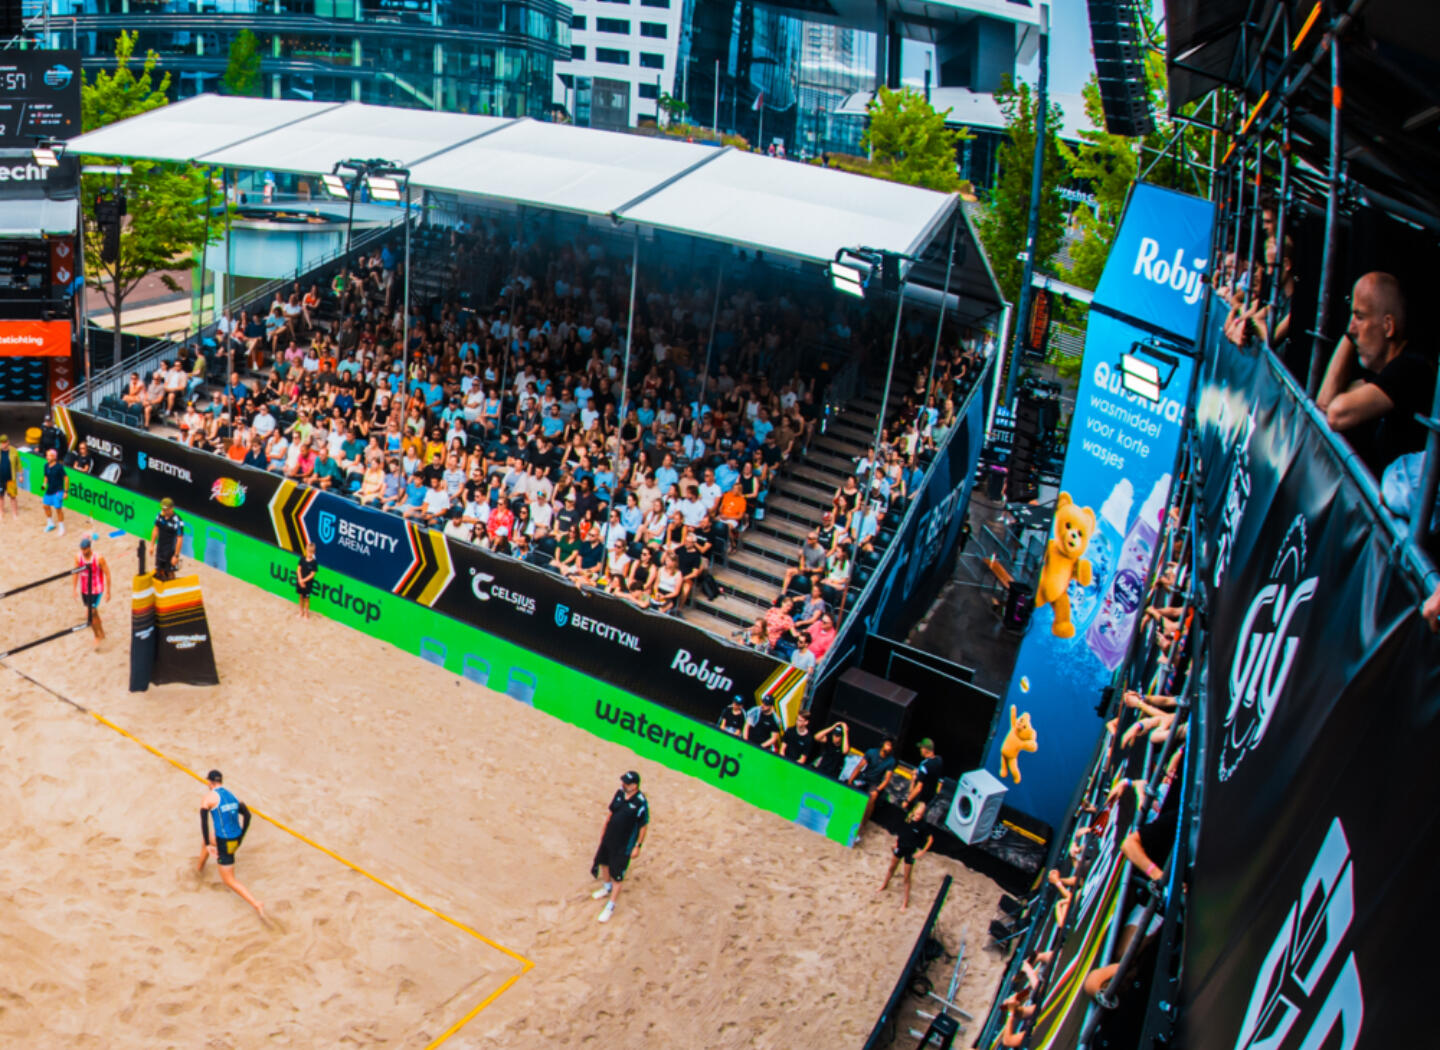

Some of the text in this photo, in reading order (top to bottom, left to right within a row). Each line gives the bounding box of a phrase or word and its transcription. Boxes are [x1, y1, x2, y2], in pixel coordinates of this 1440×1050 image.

[1133, 237, 1208, 305] Robij
[1090, 395, 1162, 438] wasmiddel
[86, 435, 112, 452] SOLID
[1082, 438, 1125, 470] wasjes
[1086, 416, 1150, 458] voor korte
[69, 483, 135, 522] aterdrop
[338, 518, 399, 553] BETCITY
[338, 537, 371, 557] ARENA
[270, 561, 381, 624] waerdrop
[490, 584, 536, 610] CELSIUS
[570, 612, 641, 652] BETCITY.NL
[670, 648, 733, 692] Robijn
[595, 699, 741, 779] waterdrop
